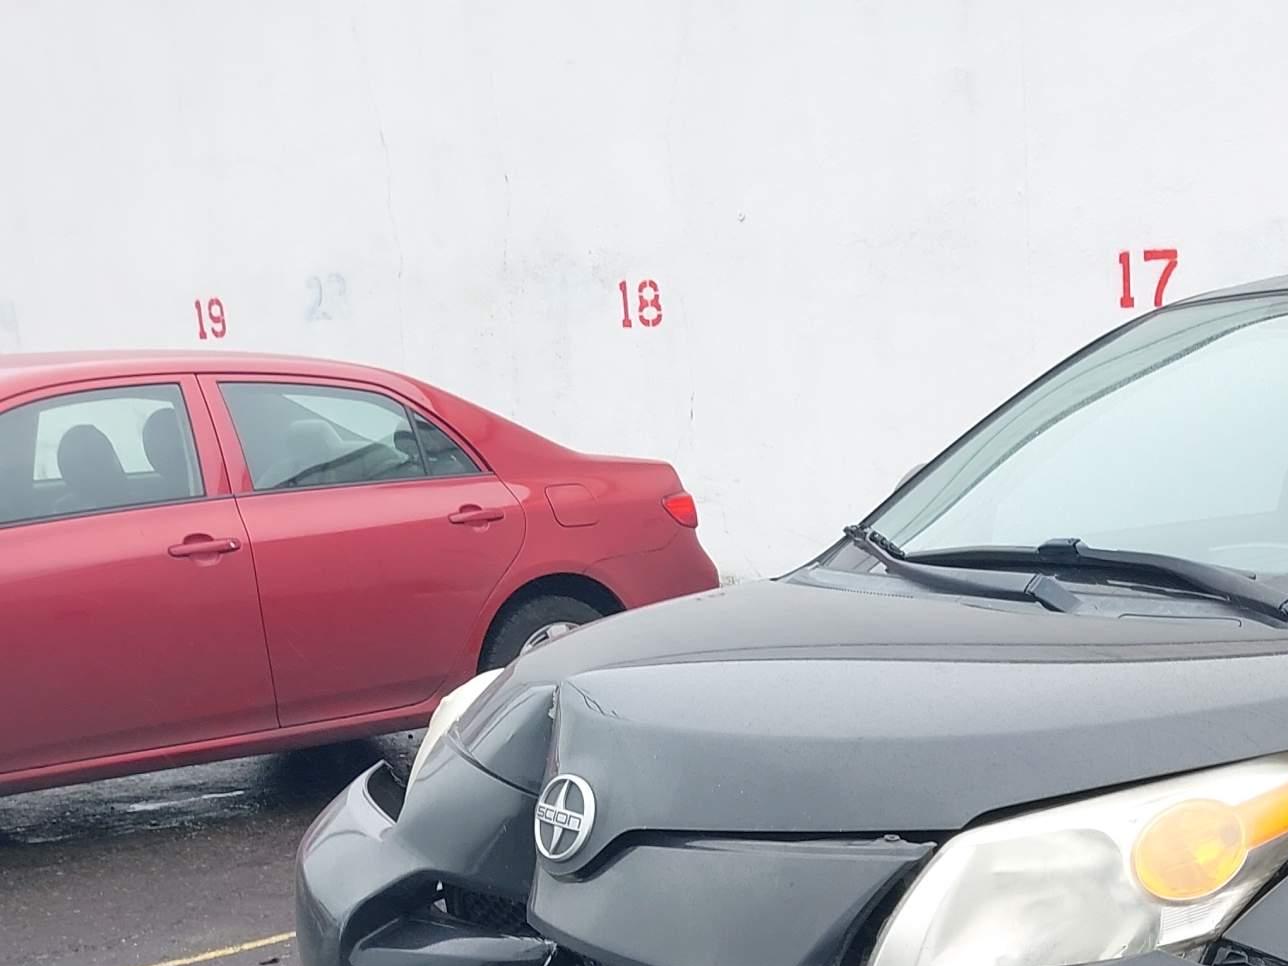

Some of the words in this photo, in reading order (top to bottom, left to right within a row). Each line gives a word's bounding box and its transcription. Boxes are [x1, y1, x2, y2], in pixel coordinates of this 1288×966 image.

[1118, 248, 1179, 309] 17
[194, 297, 227, 340] 19
[618, 279, 663, 329] 18
